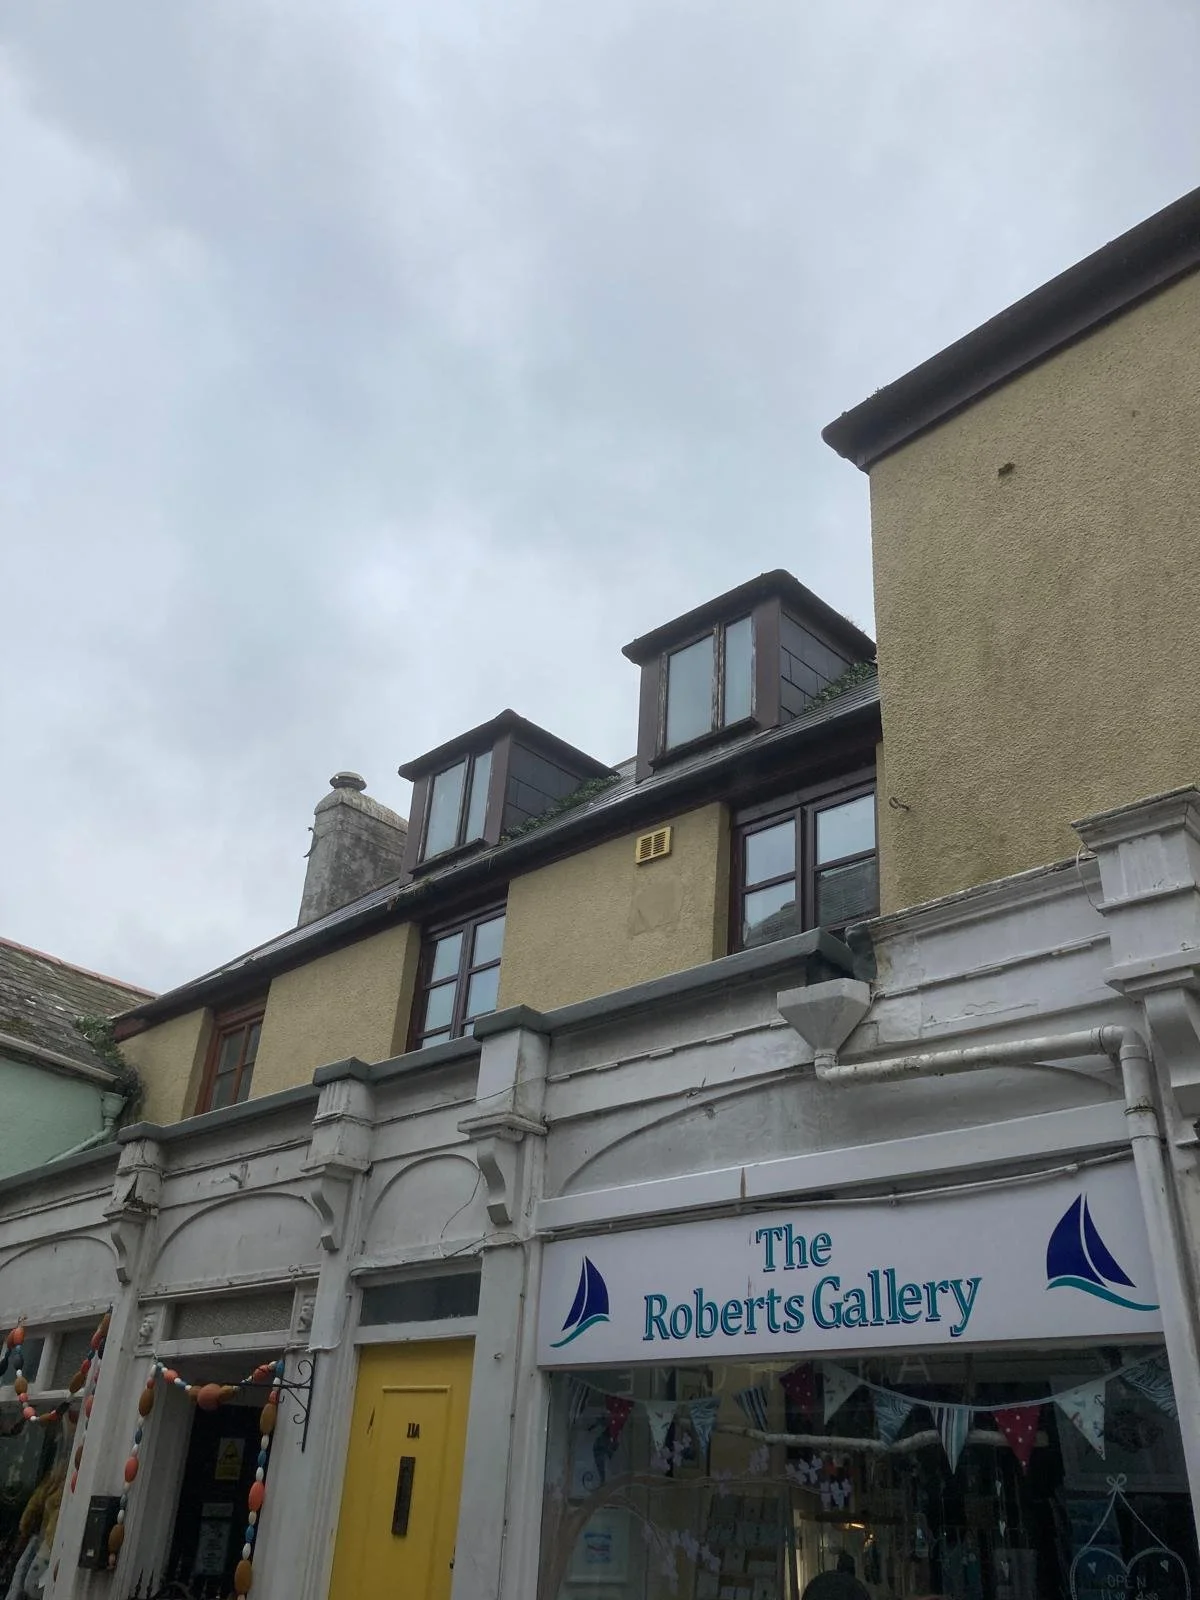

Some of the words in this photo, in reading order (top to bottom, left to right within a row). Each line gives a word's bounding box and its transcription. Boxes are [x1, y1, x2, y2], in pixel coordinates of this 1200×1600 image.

[755, 1223, 832, 1272] The
[642, 1288, 805, 1340] Roberts
[812, 1267, 983, 1337] Gallery
[1107, 1574, 1147, 1590] OPEN
